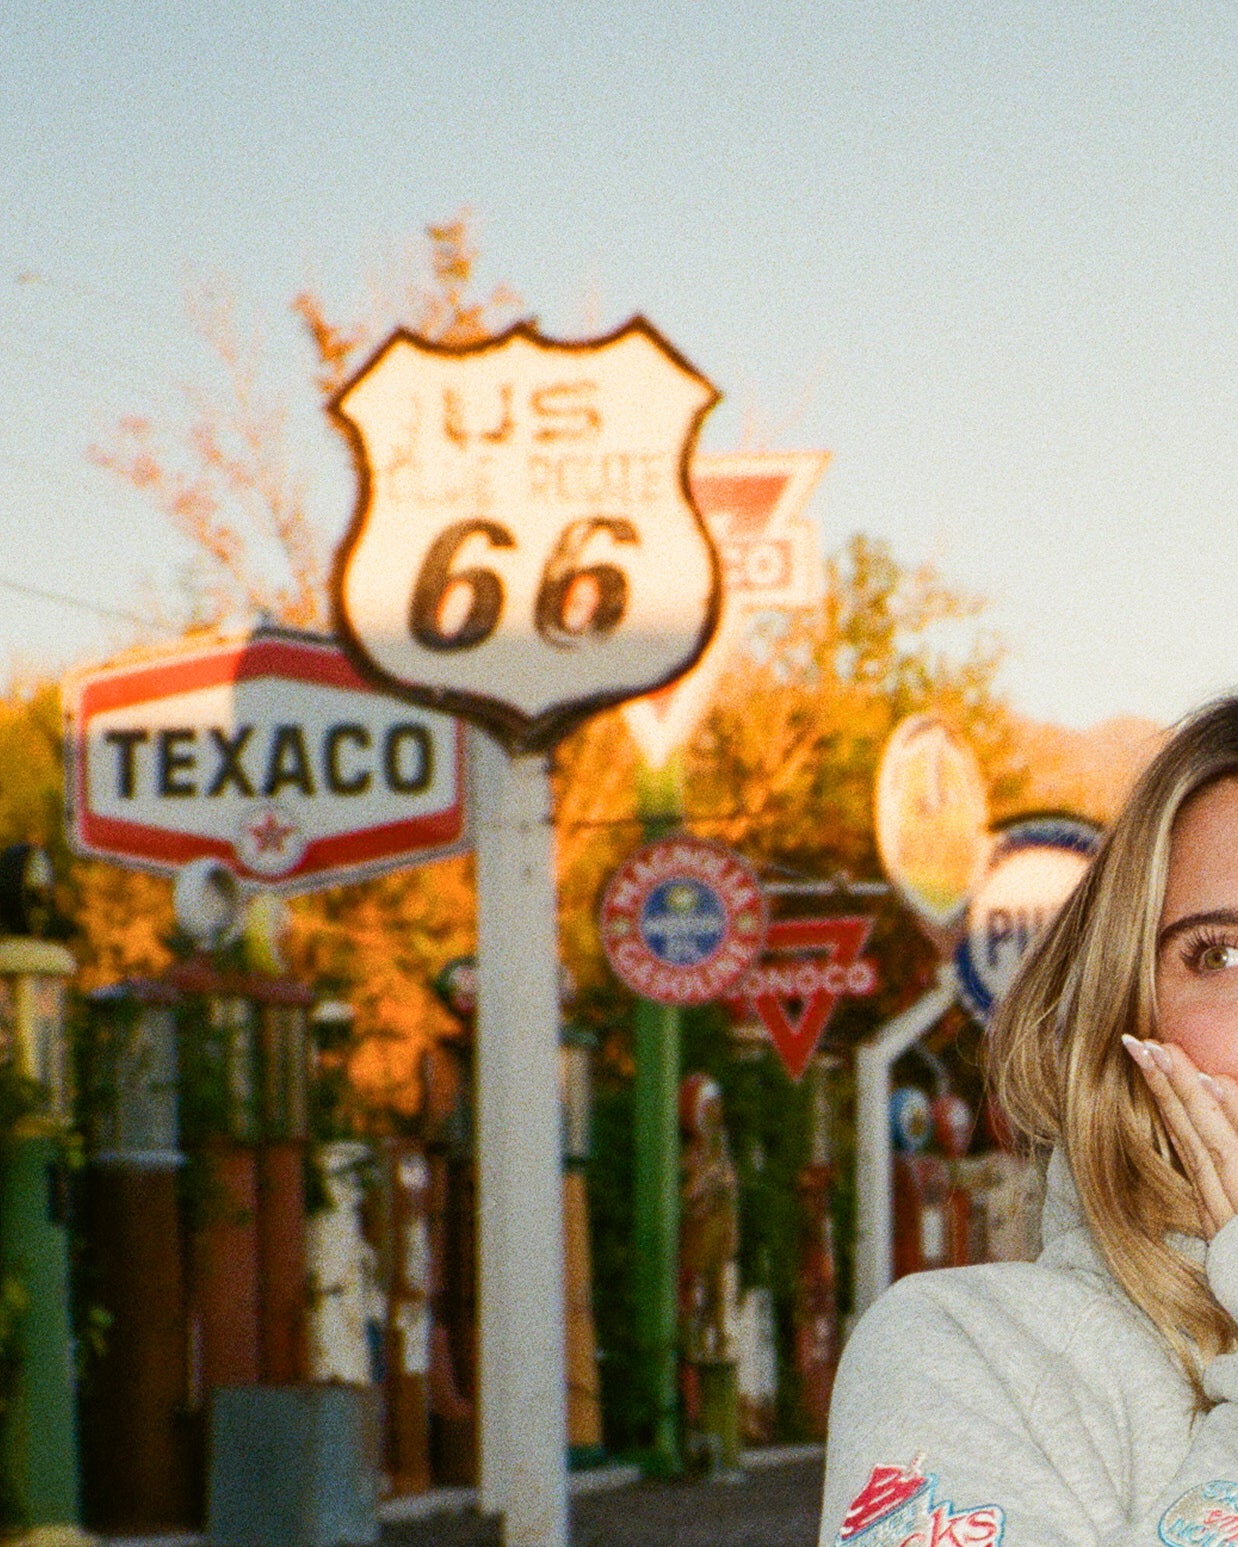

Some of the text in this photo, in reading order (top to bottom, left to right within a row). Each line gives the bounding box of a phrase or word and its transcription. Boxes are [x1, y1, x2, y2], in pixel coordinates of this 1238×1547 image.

[442, 379, 603, 450] US
[409, 517, 642, 653] 66
[104, 720, 435, 799] TEXACO
[728, 961, 876, 998] ONOCO
